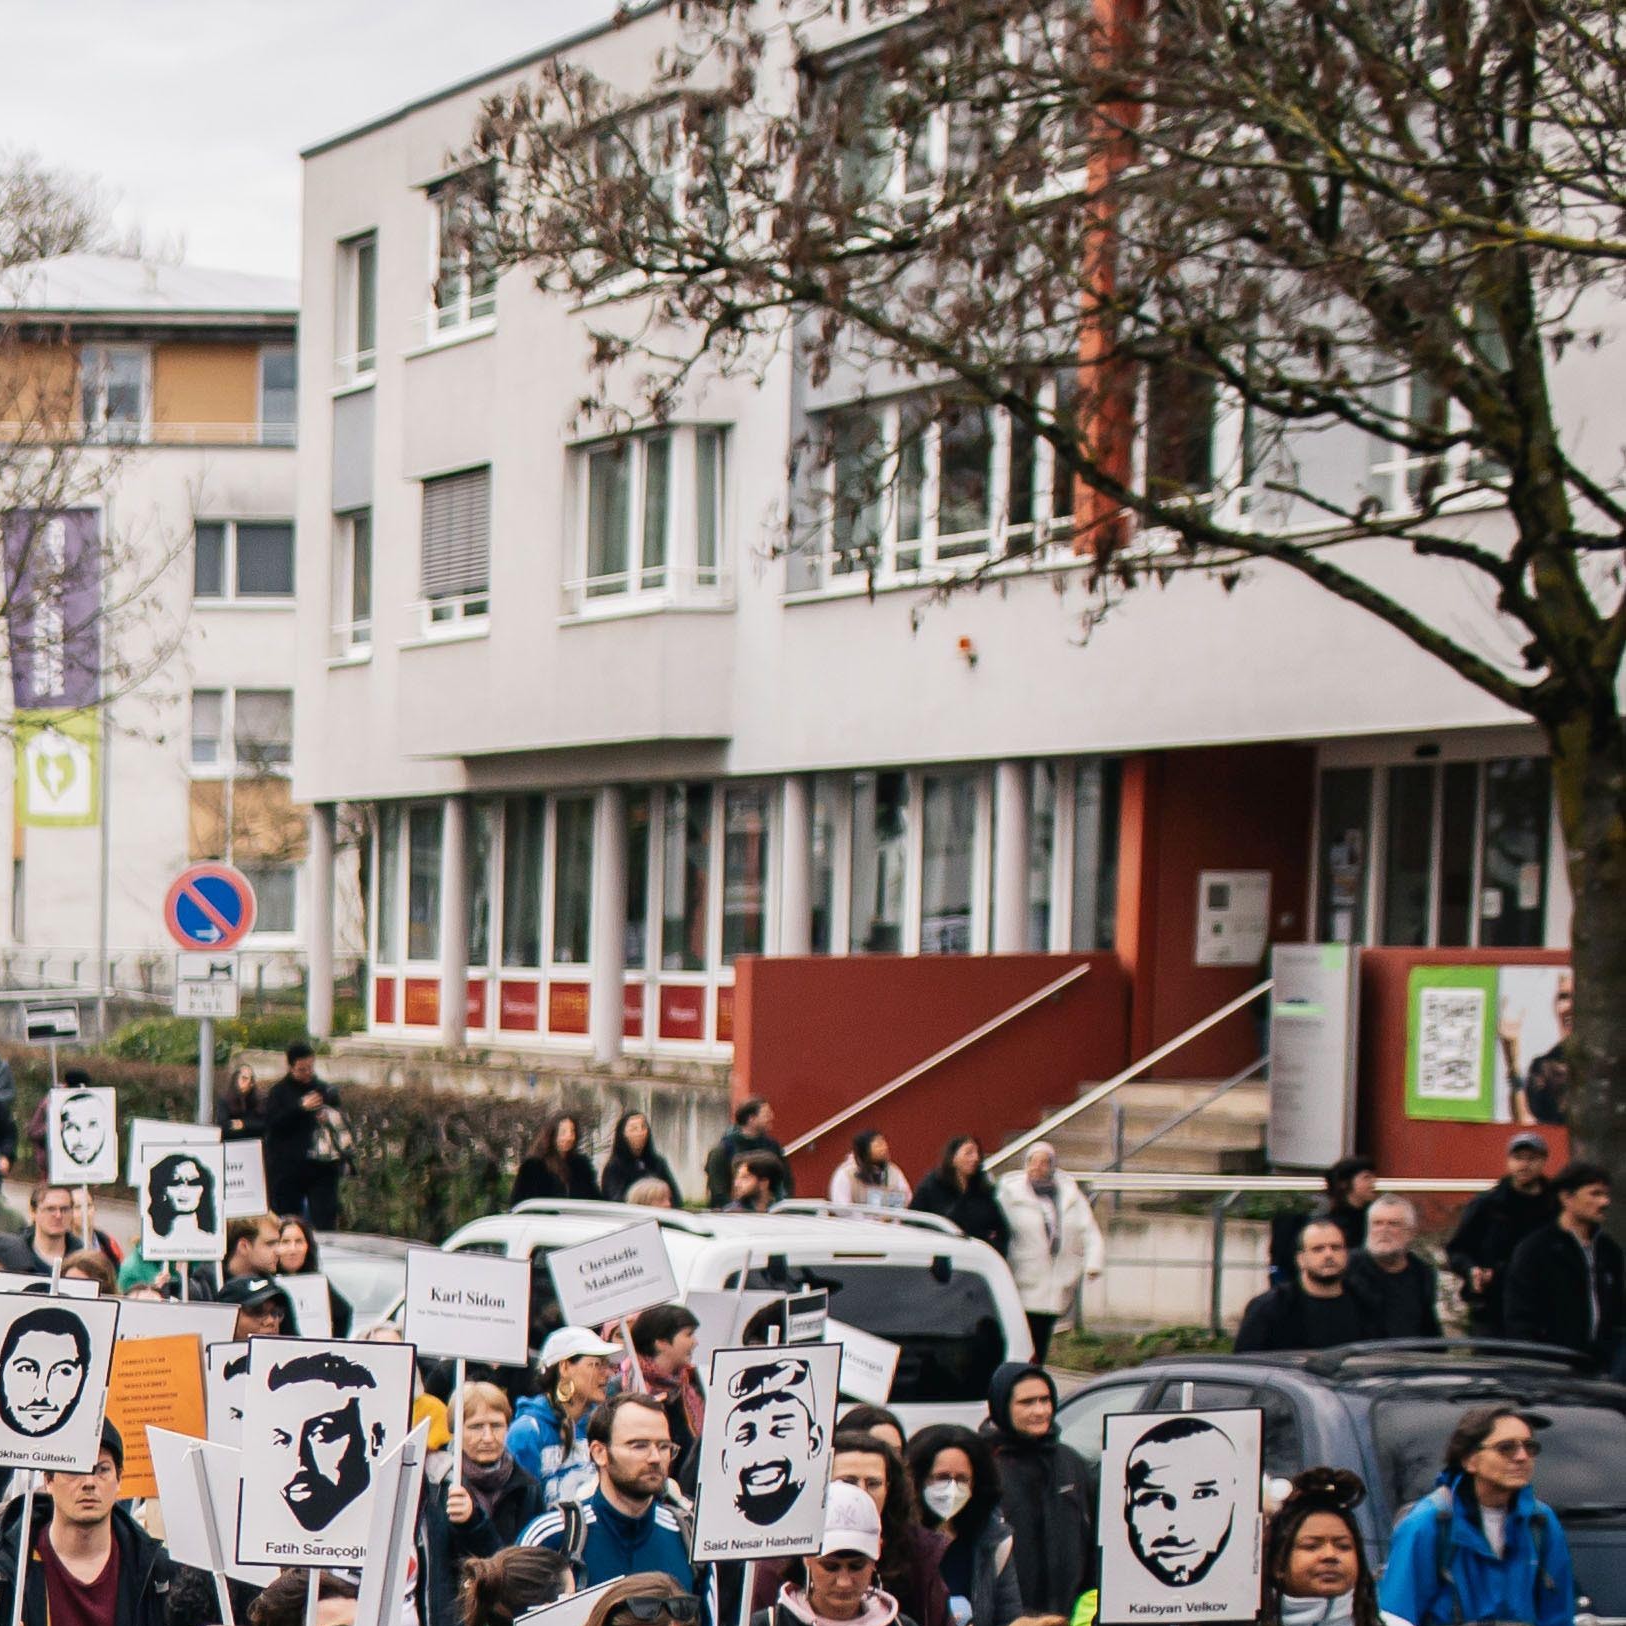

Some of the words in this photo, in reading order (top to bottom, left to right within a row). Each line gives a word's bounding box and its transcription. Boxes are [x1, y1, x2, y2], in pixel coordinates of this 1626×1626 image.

[431, 1286, 462, 1304] Karl
[466, 1291, 506, 1310] Sidon
[32, 1451, 77, 1464] Gültekin
[265, 1540, 300, 1556] Fatih
[703, 1538, 728, 1553] Said
[731, 1536, 762, 1551] Nesar
[765, 1533, 813, 1547] Hashemi
[1129, 1601, 1182, 1617] Kaloyan
[1185, 1600, 1229, 1615] Velkov
